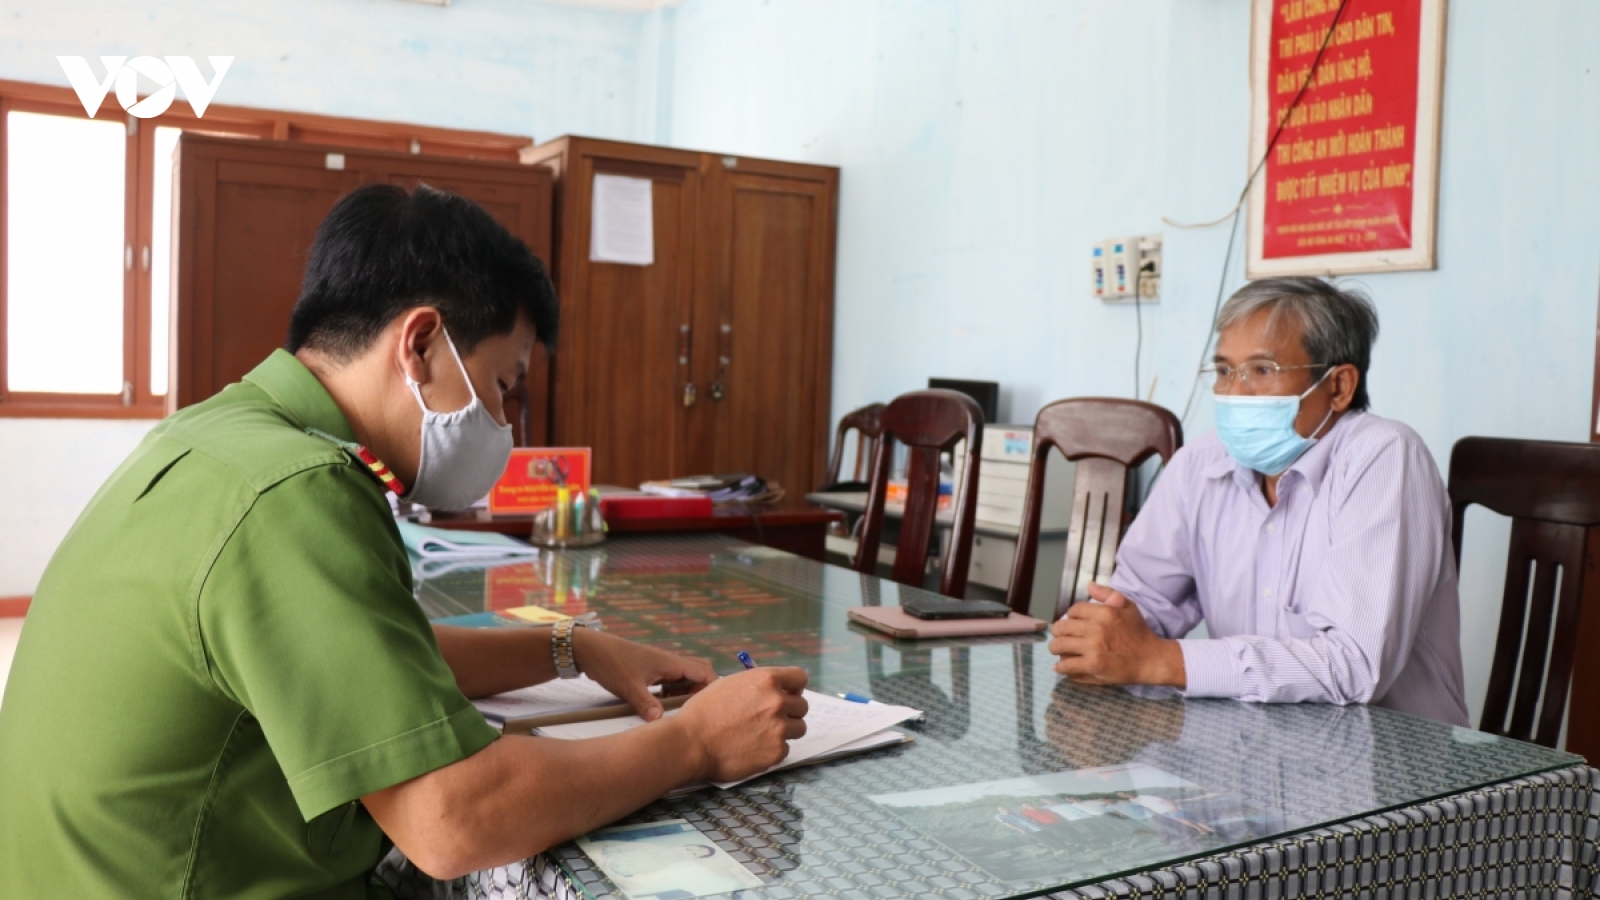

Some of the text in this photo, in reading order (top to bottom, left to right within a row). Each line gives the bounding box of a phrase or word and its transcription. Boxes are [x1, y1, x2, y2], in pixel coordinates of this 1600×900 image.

[1279, 32, 1293, 59] THÌ
[1295, 25, 1314, 55] PHẢI
[1335, 20, 1353, 46] CHO
[1355, 12, 1375, 42] DÂN
[1376, 11, 1395, 37] TIN,
[1277, 67, 1296, 95] DÂN
[1317, 58, 1336, 86] DÂN
[1309, 96, 1327, 124] VÀO
[1327, 91, 1353, 121] NHÂN
[1353, 87, 1373, 117] DÂN
[1275, 121, 1405, 166] THÌ CÔNG AN MỚI HOÀN THÀNH
[1275, 177, 1300, 205] ĐƯỢC
[1300, 170, 1317, 199] TỐT
[1318, 168, 1346, 200] NHIỆM
[1347, 170, 1361, 197] VỤ
[1362, 159, 1381, 191] CỦA
